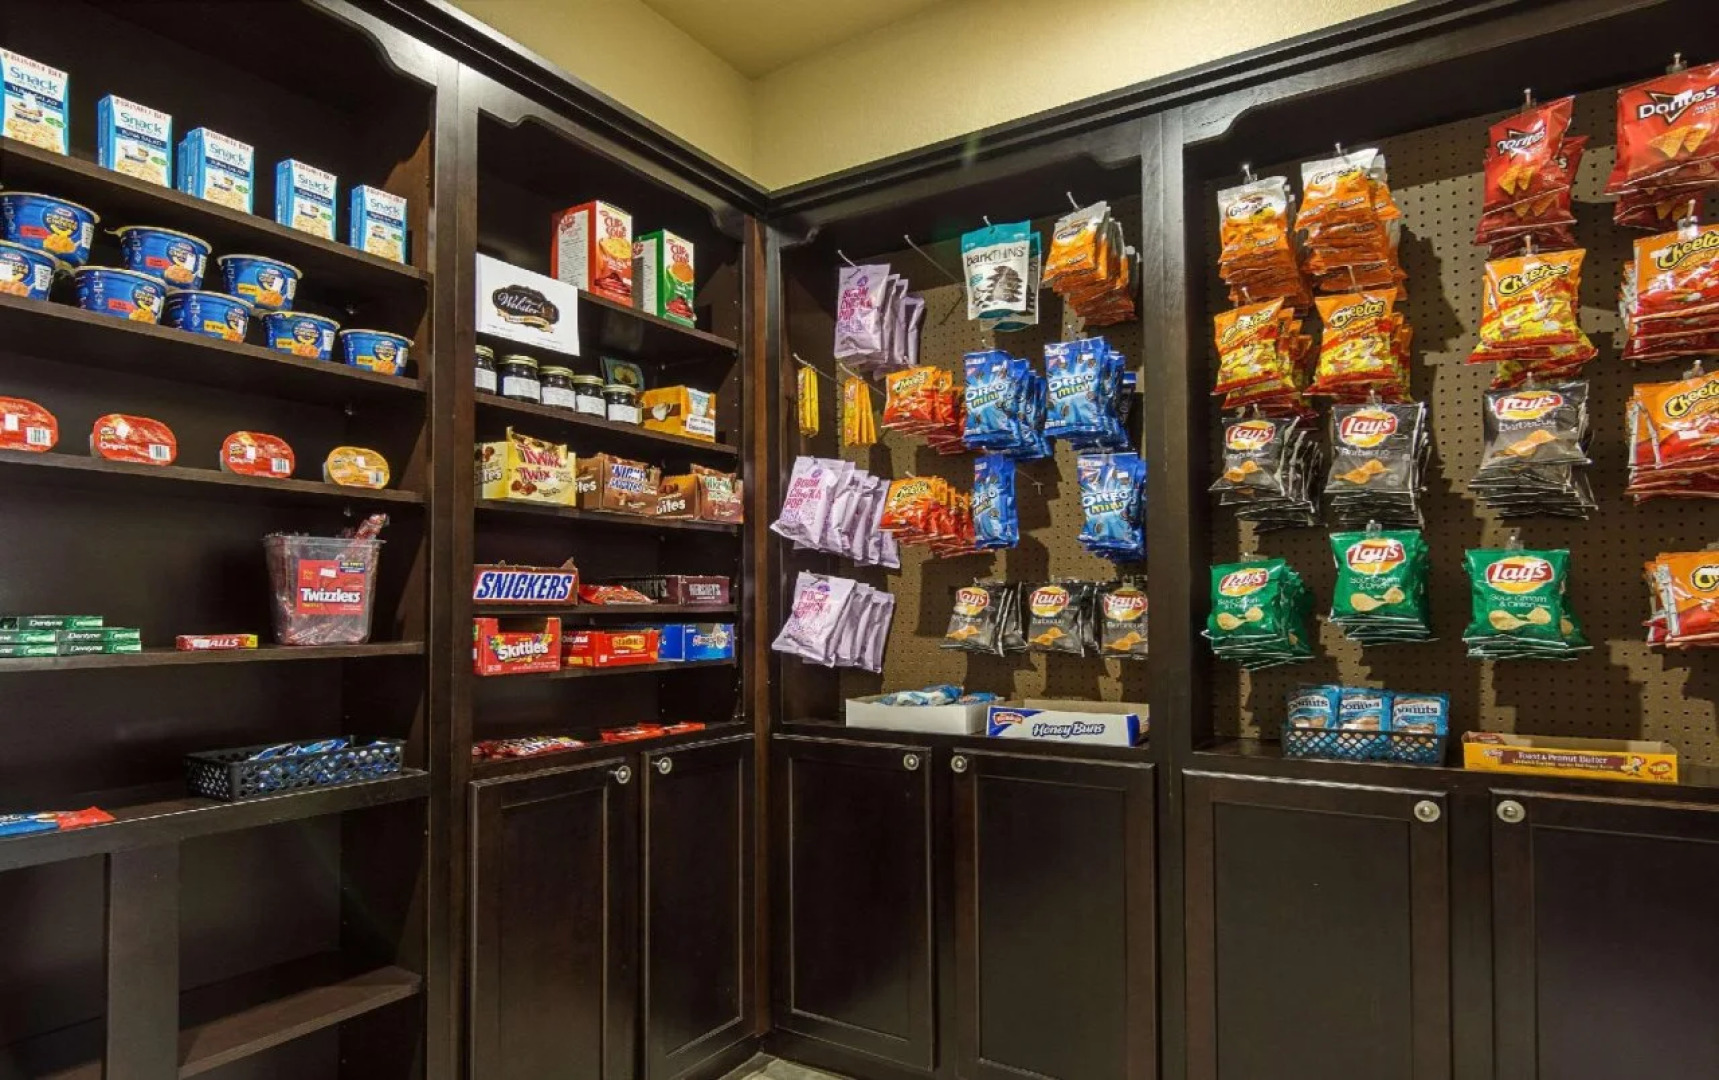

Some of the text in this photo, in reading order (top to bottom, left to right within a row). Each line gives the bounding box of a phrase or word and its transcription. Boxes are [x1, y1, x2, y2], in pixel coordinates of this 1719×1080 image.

[10, 66, 57, 92] Snack
[1639, 86, 1715, 119] Doritos
[120, 112, 161, 134] Snack
[210, 143, 246, 164] Snack
[1656, 230, 1719, 271] Cheeto
[1499, 264, 1570, 295] Cheetos
[1330, 299, 1386, 328] Cheetos
[972, 392, 999, 408] mini
[1057, 384, 1089, 399] mini
[1665, 380, 1719, 419] Cheeto
[1228, 425, 1273, 442] Lay's
[1345, 417, 1394, 435] Lay's
[576, 481, 597, 493] ites
[1083, 489, 1129, 508] OREO
[1091, 501, 1124, 514] mini
[1351, 543, 1400, 564] Lay's
[1492, 560, 1547, 581] Lay's
[477, 572, 573, 599] SNICKERS
[300, 587, 361, 603] Twizzlers
[1033, 590, 1067, 606] Lay's
[30, 619, 63, 628] Dentyne
[67, 632, 101, 641] Dentyne
[70, 645, 103, 653] Dentyne
[497, 640, 549, 661] Skittles
[1033, 721, 1104, 738] Honey Buns
[1518, 752, 1540, 760] Toast
[1548, 754, 1577, 763] Peanut
[1579, 756, 1608, 765] Butter
